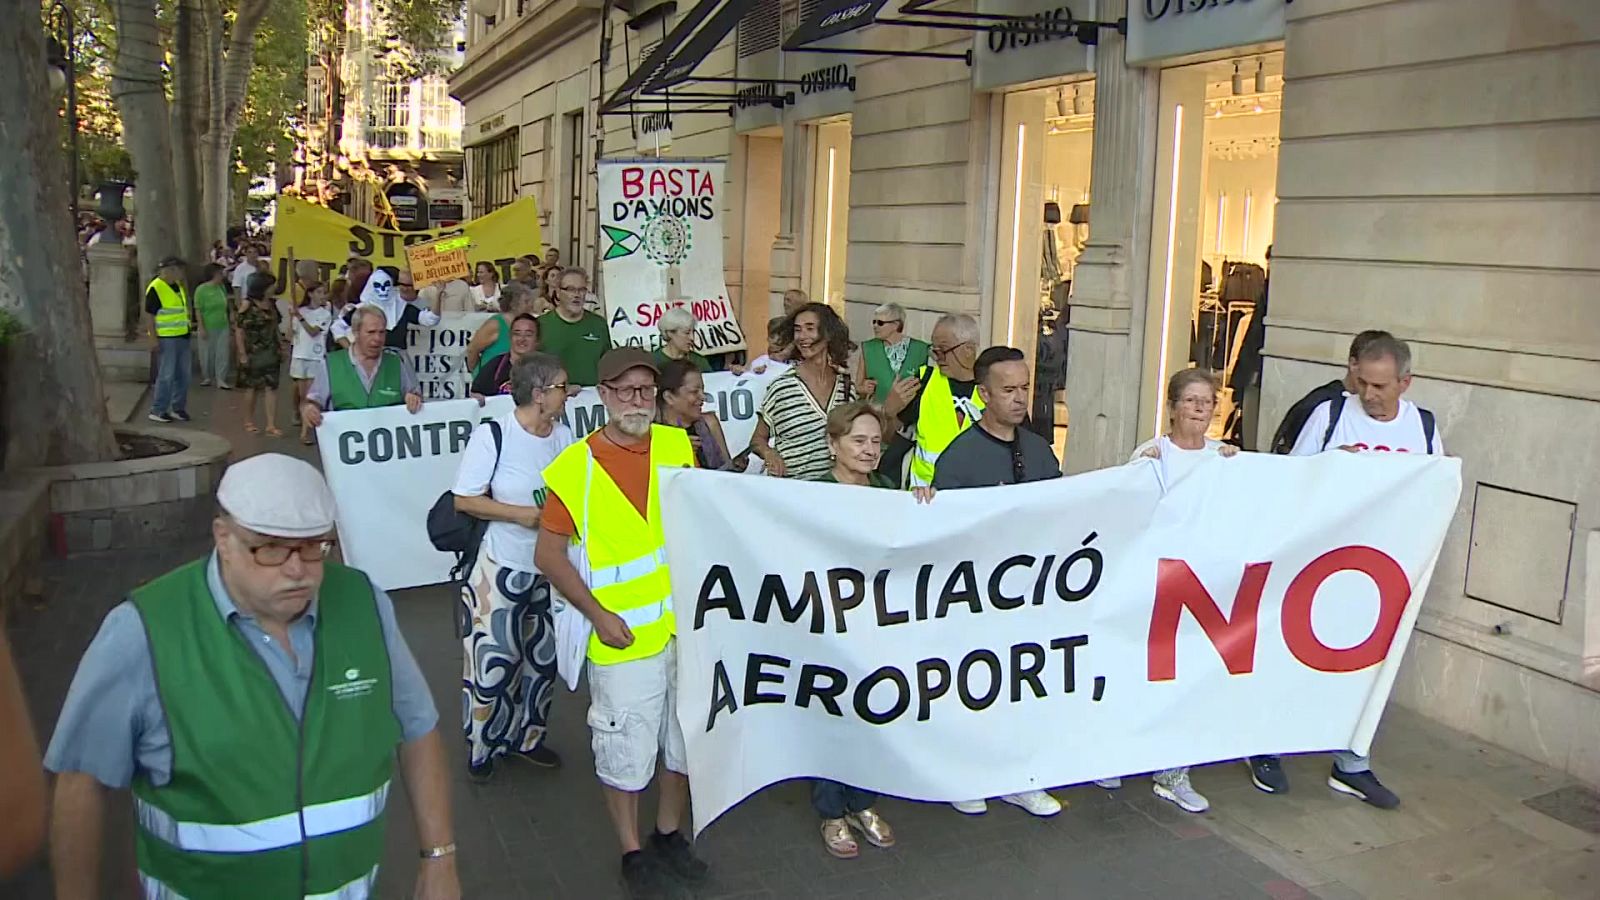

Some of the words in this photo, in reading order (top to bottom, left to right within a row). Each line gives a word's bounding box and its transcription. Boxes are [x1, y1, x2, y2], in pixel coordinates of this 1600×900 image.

[801, 63, 849, 96] OYSHO
[622, 167, 715, 199] BASTA
[611, 307, 632, 328] A
[338, 416, 493, 465] CONTR
[693, 532, 1103, 634] AMPLIACIÓ
[706, 634, 1106, 732] AEROPORT,
[1147, 545, 1412, 682] NO
